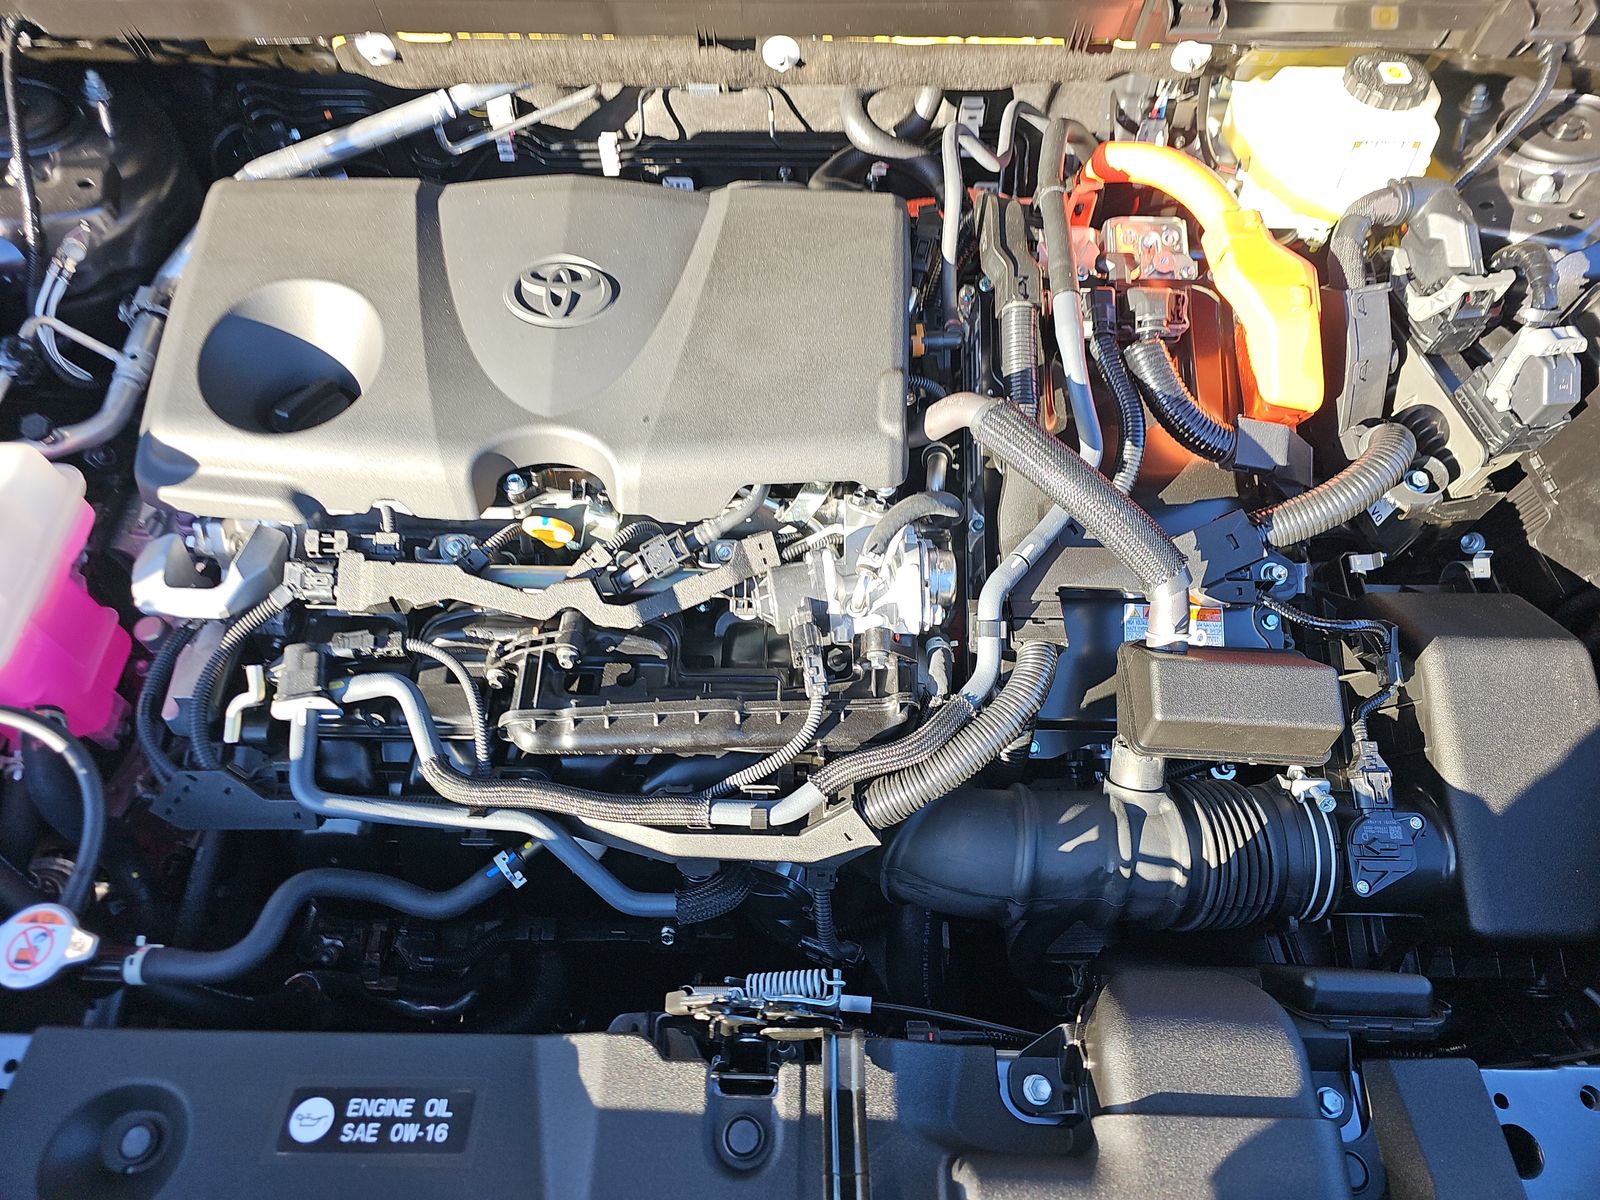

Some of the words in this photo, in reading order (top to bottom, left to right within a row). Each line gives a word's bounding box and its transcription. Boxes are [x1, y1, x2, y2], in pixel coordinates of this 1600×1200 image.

[346, 1098, 416, 1118] ENGINE
[424, 1098, 453, 1118] OIL
[339, 1122, 382, 1143] SAE
[389, 1122, 450, 1143] 0W-16
